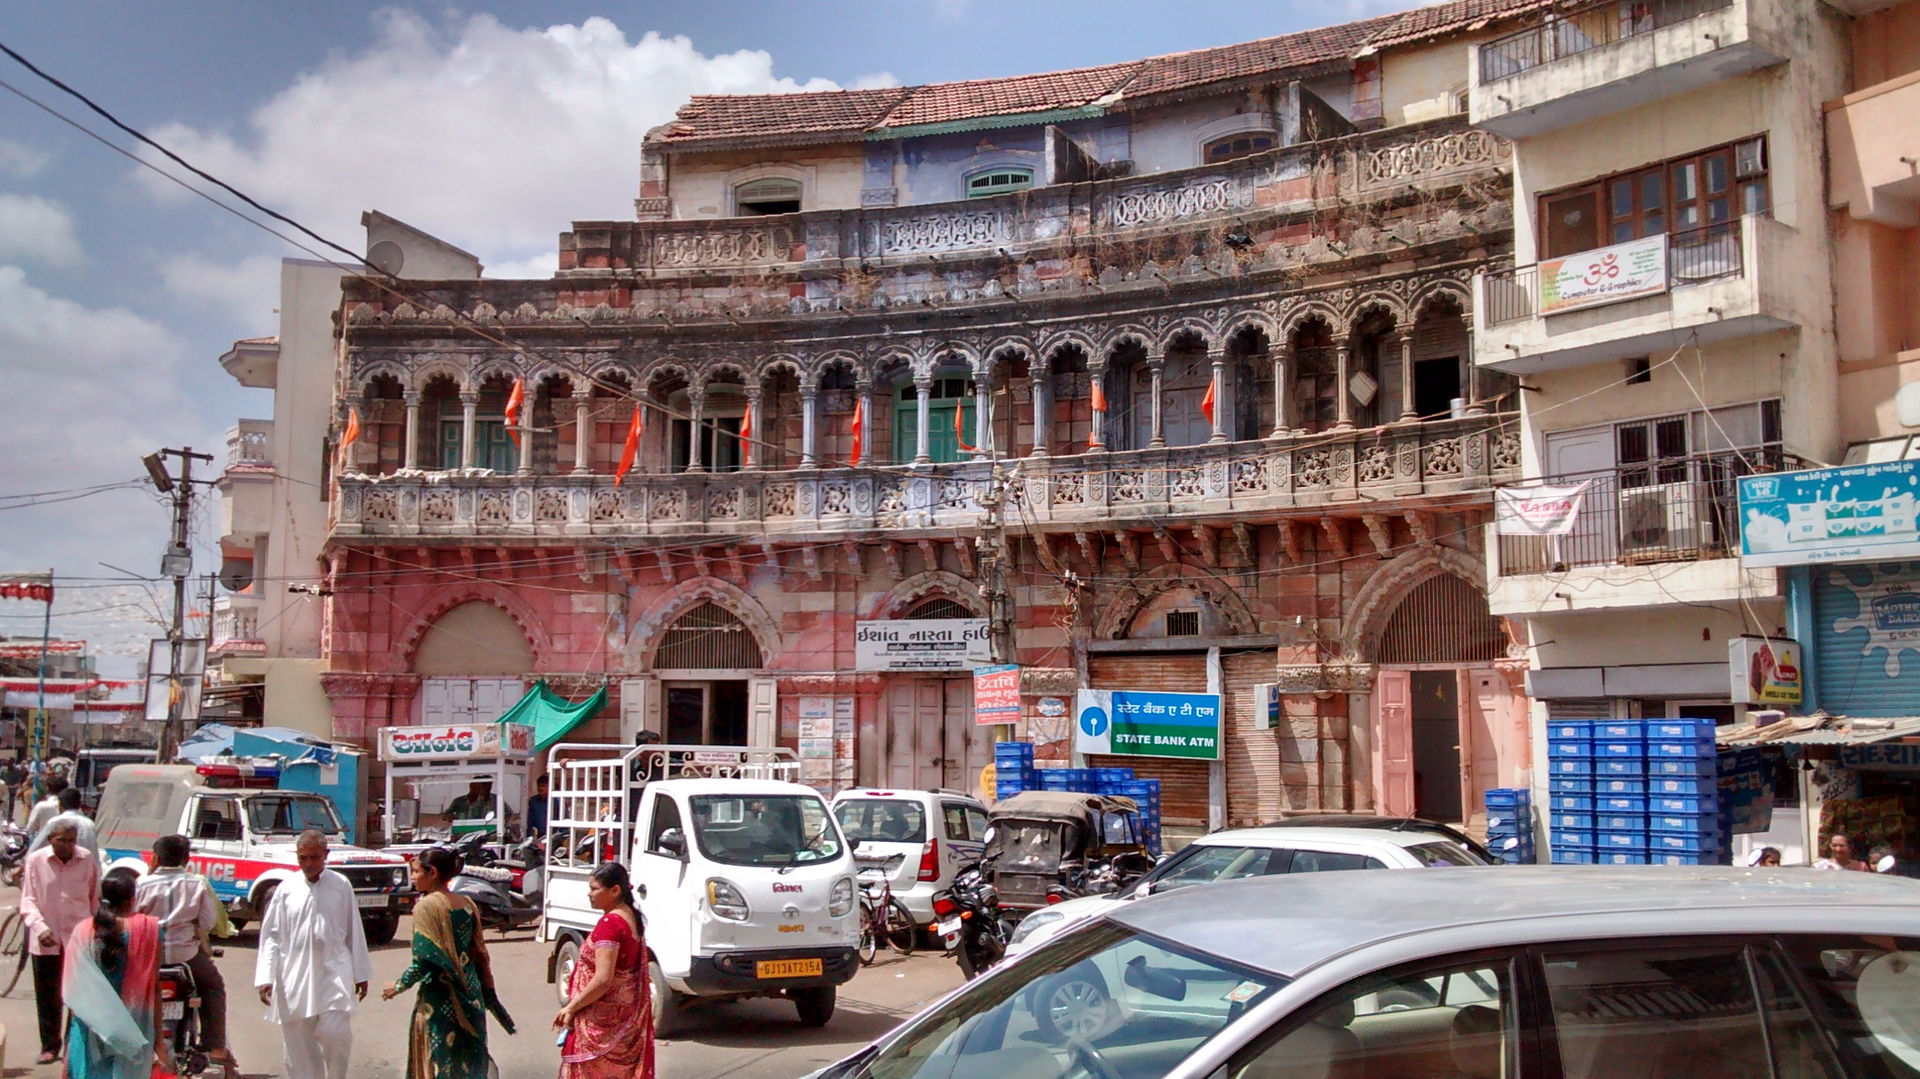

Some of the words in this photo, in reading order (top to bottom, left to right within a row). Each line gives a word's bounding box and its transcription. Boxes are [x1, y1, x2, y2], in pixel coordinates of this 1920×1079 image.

[1876, 602, 1920, 617] MOTHE
[857, 627, 899, 641] ઈશાંત
[908, 629, 952, 641] નાસ્તા
[962, 624, 991, 641] હાઉ
[1117, 702, 1139, 714] स्टेट
[1143, 702, 1165, 714] बैंक
[1168, 707, 1176, 716] ए
[1180, 704, 1192, 716] टी
[1196, 707, 1214, 717] एम
[1116, 734, 1151, 744] STATE
[1154, 735, 1186, 746] BANK
[1189, 737, 1214, 747] ATM
[186, 862, 235, 882] OLICE
